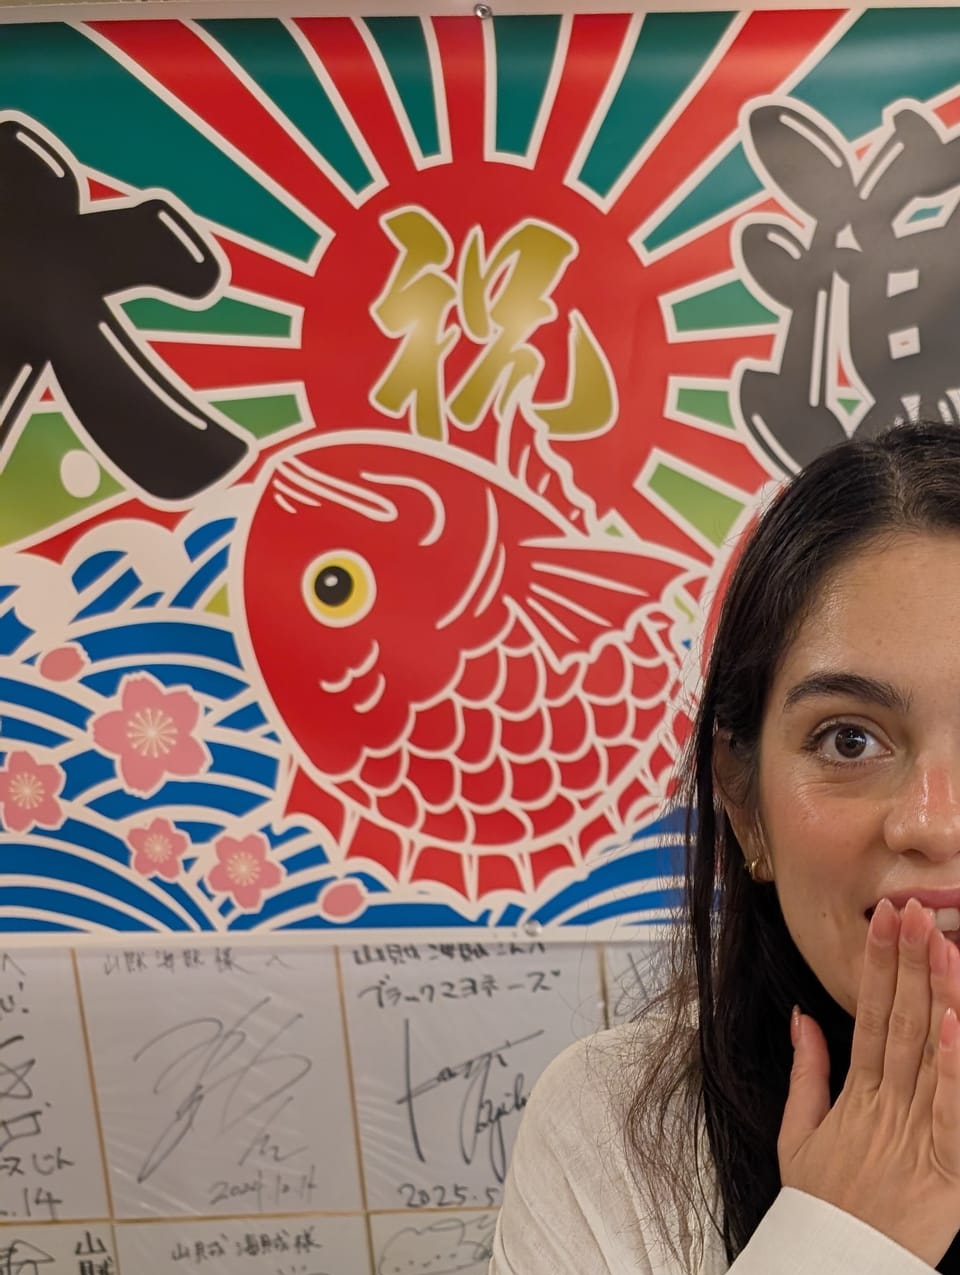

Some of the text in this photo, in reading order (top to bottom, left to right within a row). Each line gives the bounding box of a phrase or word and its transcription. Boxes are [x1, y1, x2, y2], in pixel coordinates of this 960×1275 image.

[371, 206, 618, 442] 祝
[357, 969, 562, 1008] ブラックマヨネーズ
